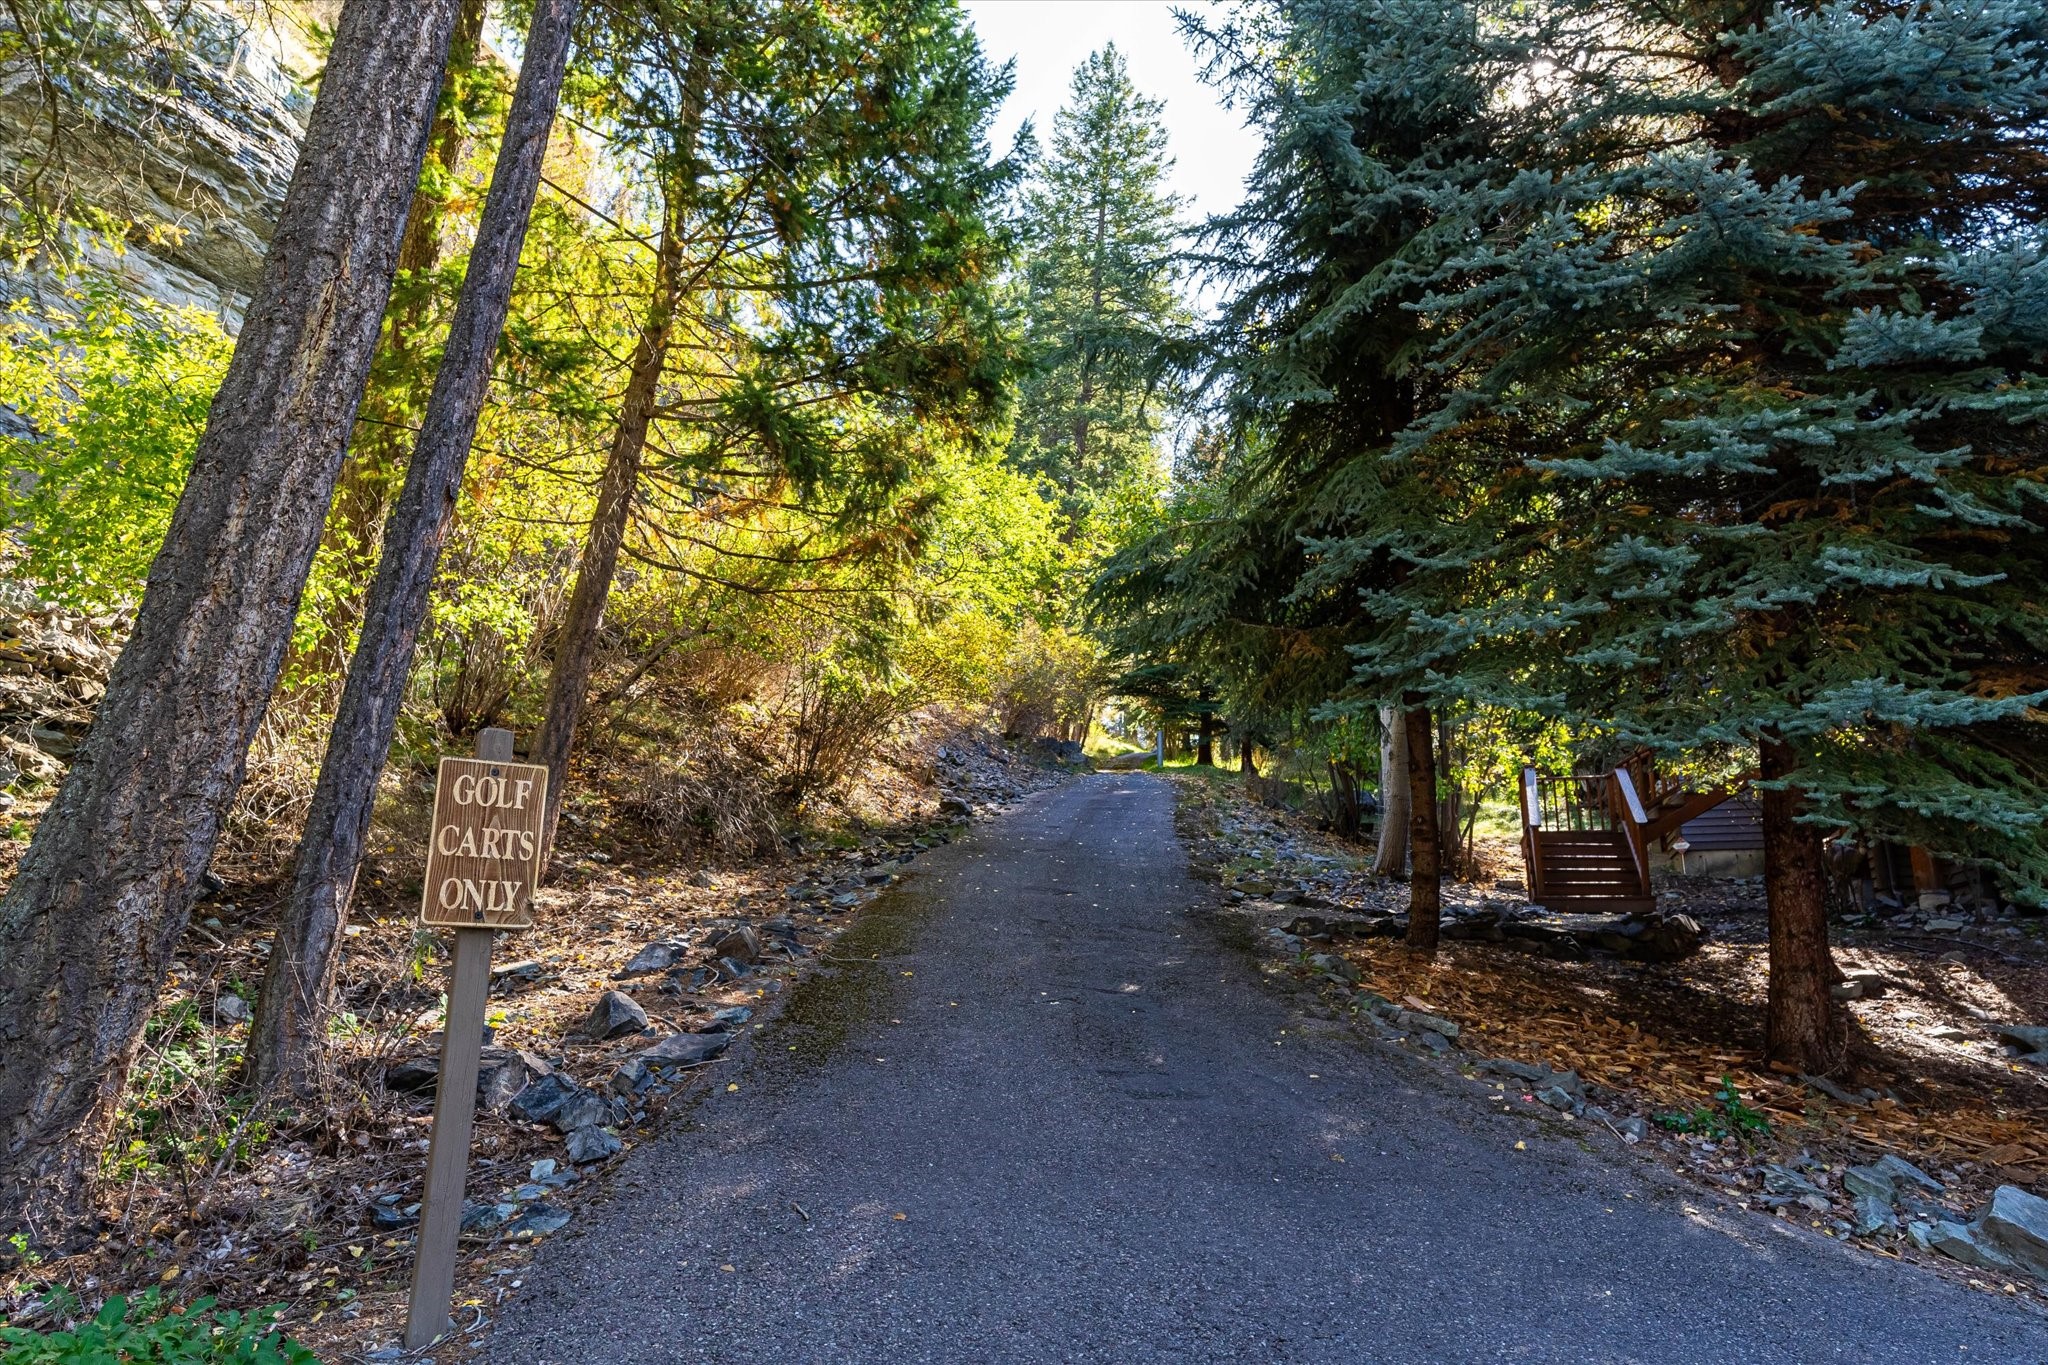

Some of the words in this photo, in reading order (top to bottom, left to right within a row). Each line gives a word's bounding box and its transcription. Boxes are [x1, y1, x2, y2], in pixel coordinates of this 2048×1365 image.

[453, 774, 532, 809] GOLF
[437, 825, 534, 861] CARTS
[439, 877, 522, 911] ONLY
